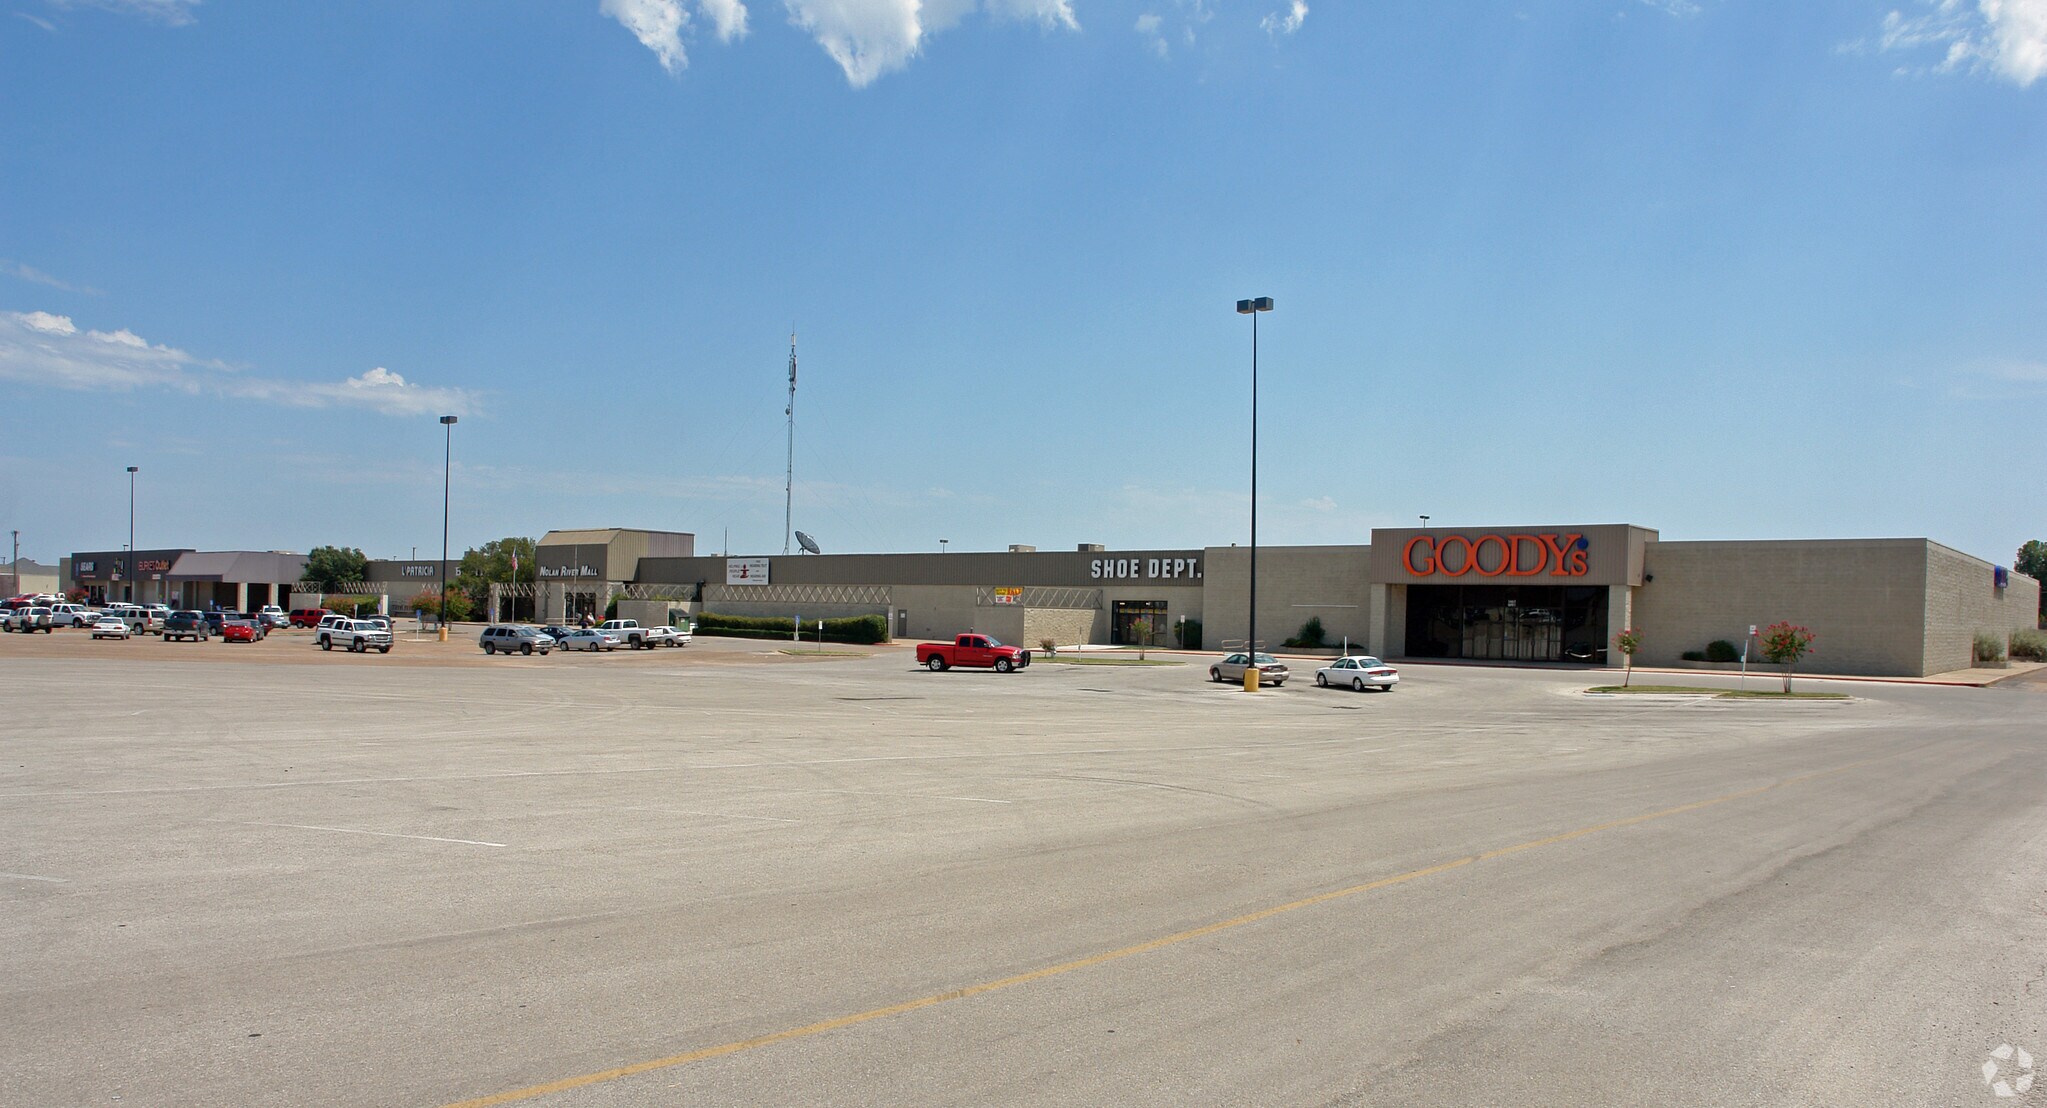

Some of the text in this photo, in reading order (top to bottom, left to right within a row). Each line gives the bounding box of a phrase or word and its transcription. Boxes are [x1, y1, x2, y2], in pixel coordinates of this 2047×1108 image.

[81, 562, 94, 571] SEARS
[401, 566, 434, 576] L'PATRICIA
[540, 565, 598, 576] NOLAN RIVER MALL
[1091, 558, 1202, 579] SHOE DEPT.
